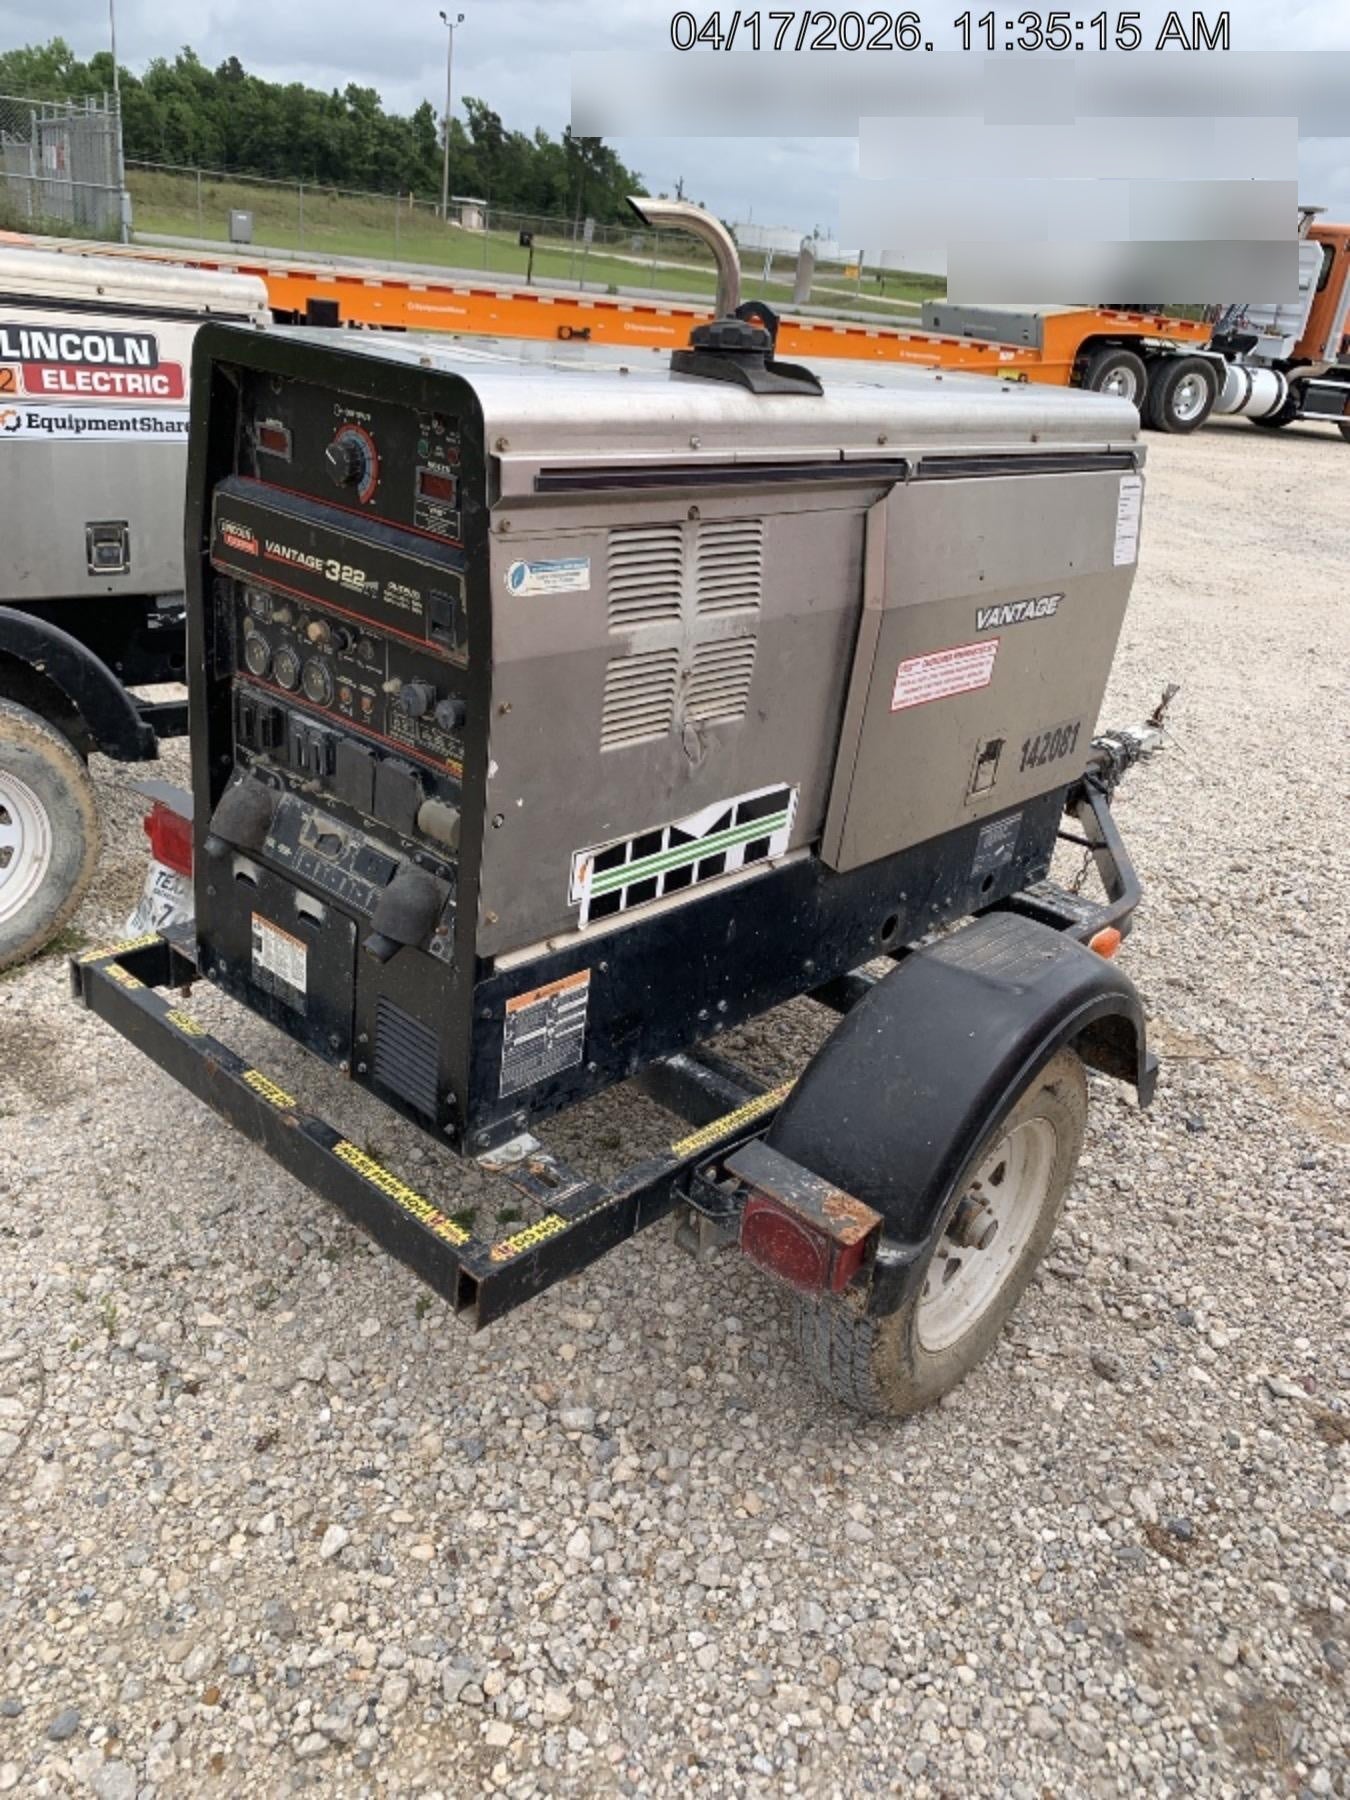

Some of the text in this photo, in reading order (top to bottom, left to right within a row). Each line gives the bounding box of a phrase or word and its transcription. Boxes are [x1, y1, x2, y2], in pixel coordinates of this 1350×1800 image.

[0, 328, 151, 366] LINCOLN
[40, 368, 170, 395] ELECTRIC
[264, 538, 323, 571] VANTAGE
[324, 558, 366, 588] 322
[976, 593, 1064, 632] VANTAGE
[1019, 720, 1081, 773] 142081
